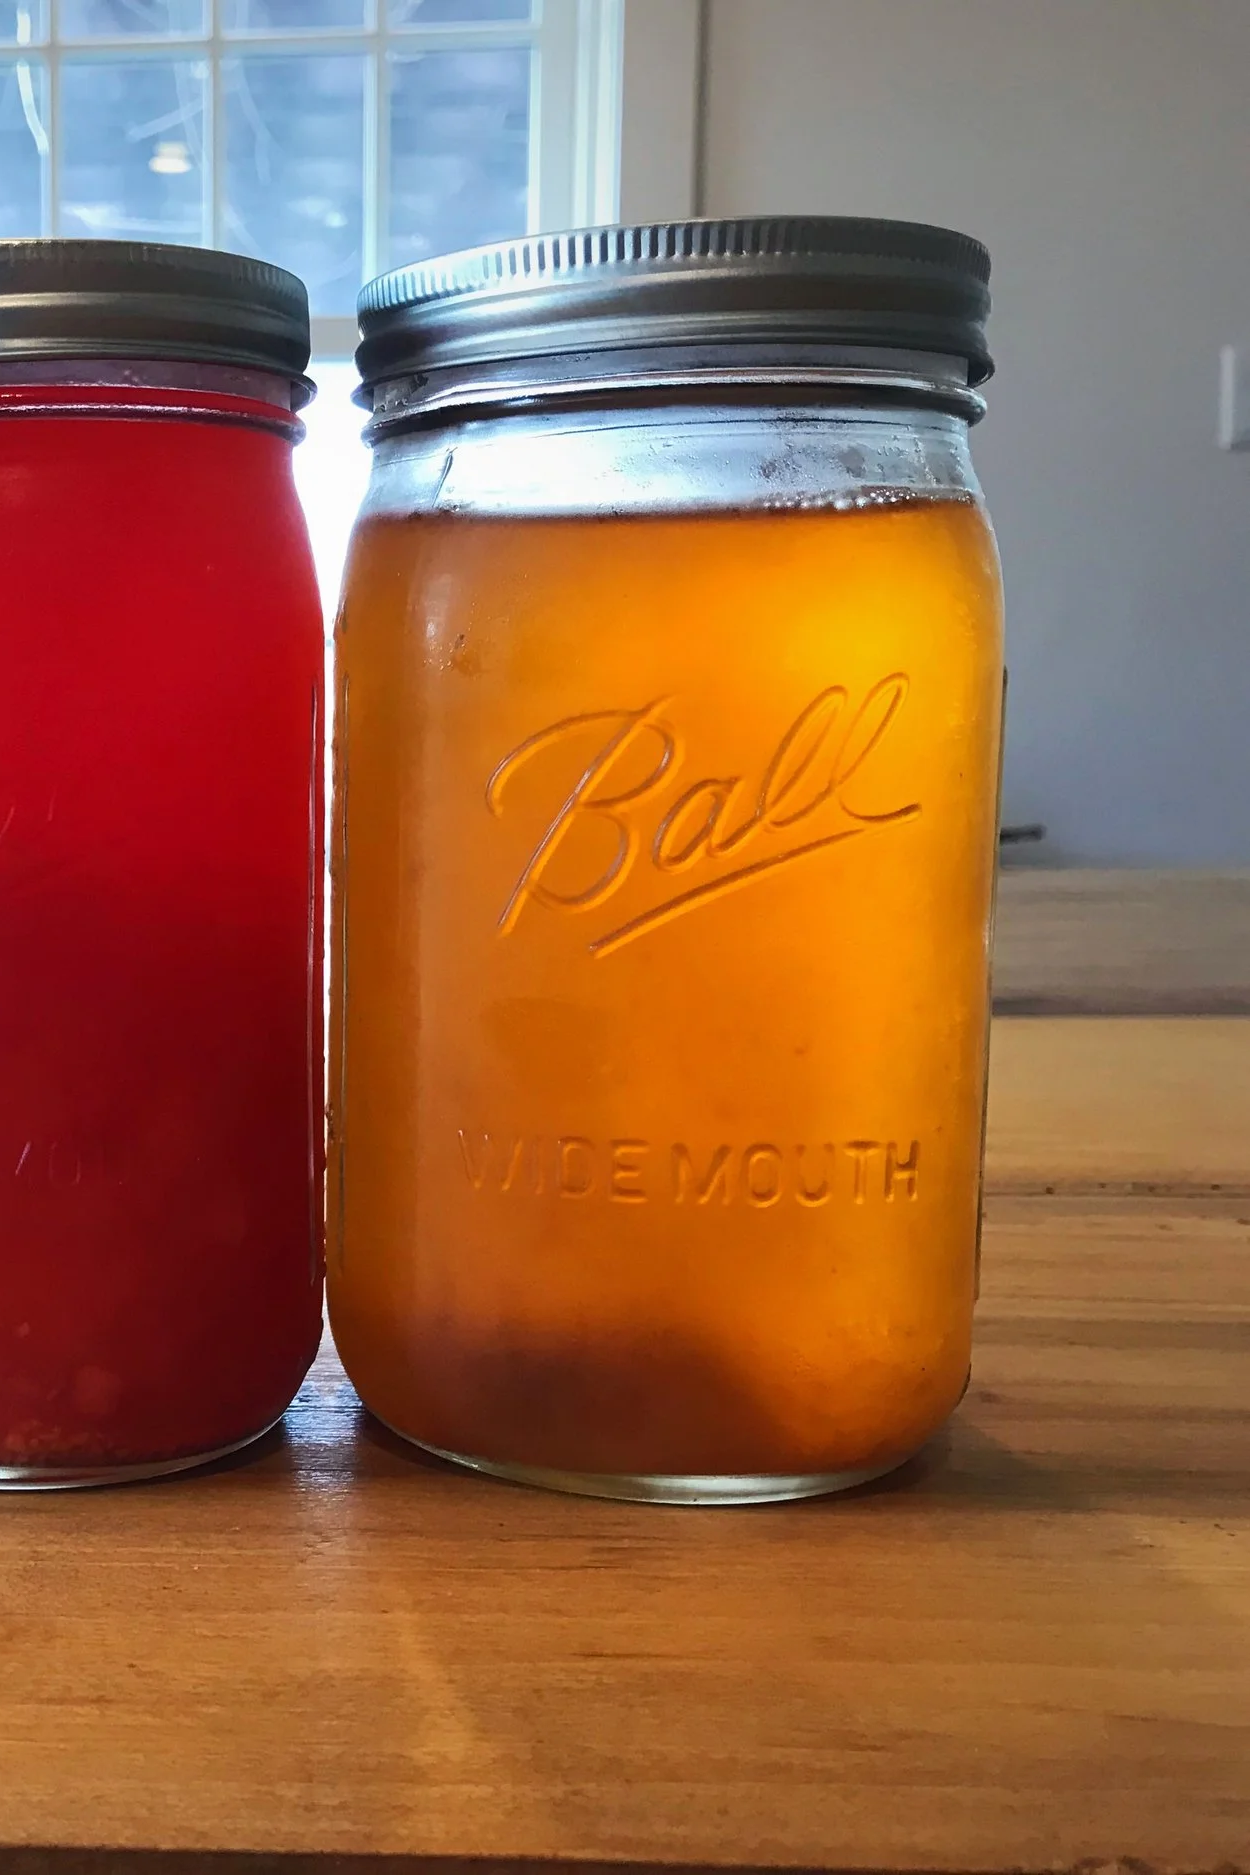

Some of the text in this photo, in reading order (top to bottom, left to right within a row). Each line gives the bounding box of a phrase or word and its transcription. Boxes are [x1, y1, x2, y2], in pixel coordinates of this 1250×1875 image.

[486, 672, 922, 945] Ball
[456, 1129, 920, 1208] WIDE MOUTH
